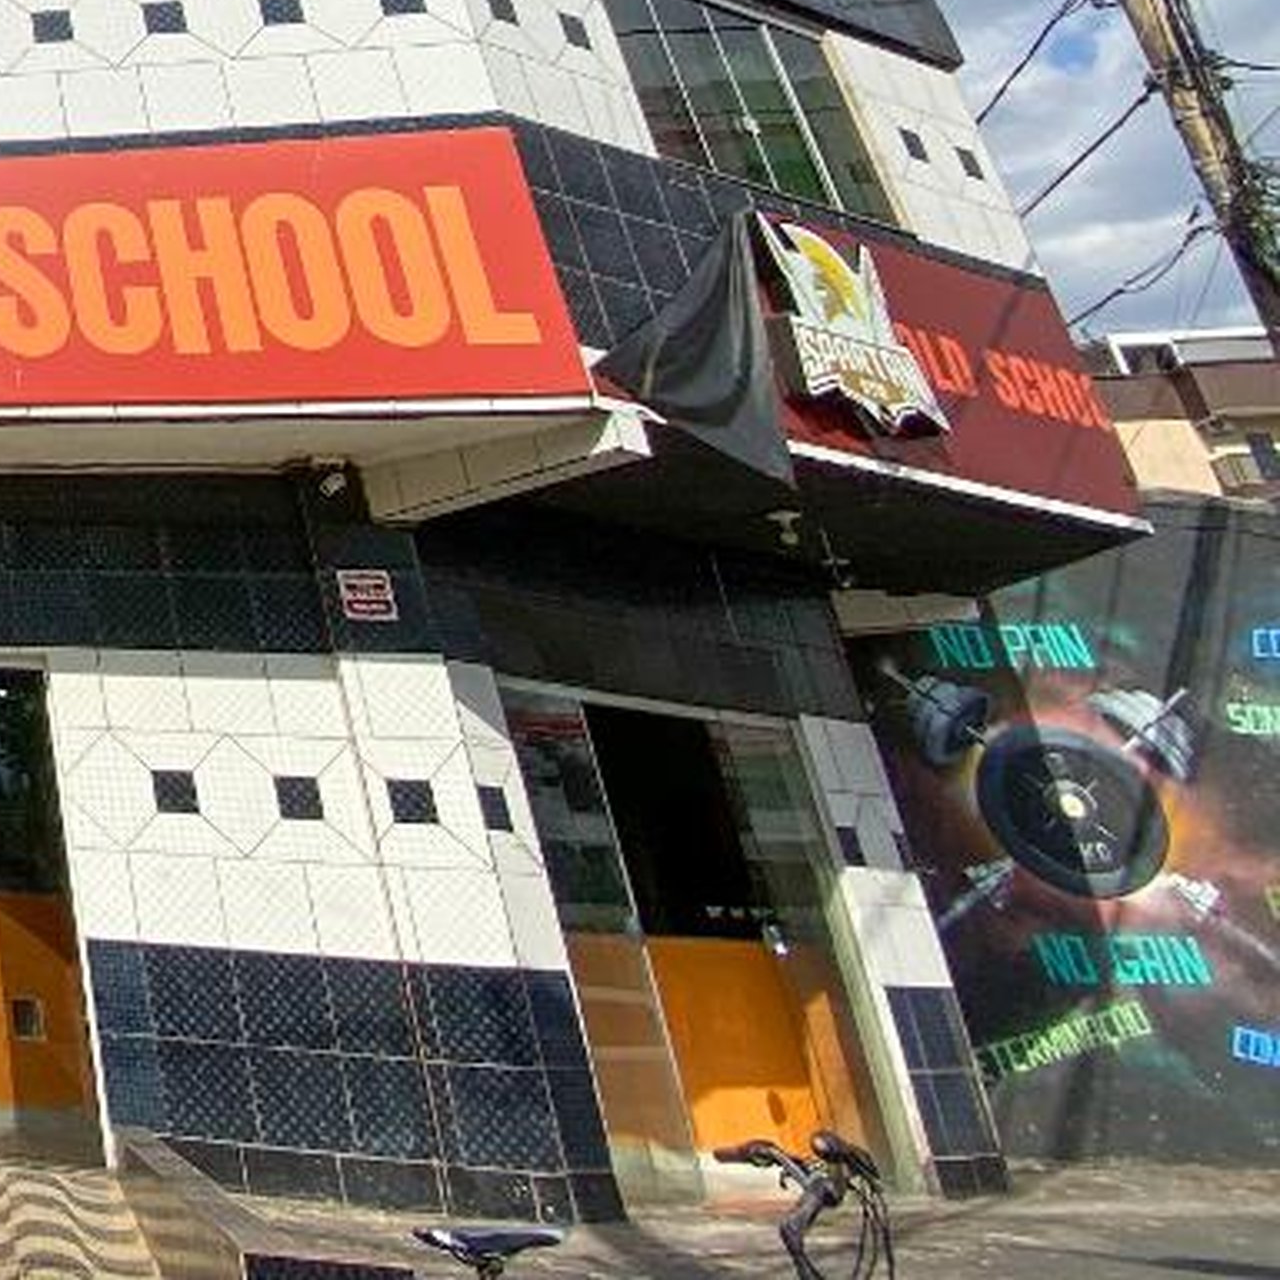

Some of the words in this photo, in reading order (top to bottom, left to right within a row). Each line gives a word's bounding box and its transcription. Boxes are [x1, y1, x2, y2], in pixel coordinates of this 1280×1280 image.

[986, 349, 1113, 433] SCHO
[929, 624, 993, 668] NO
[998, 623, 1096, 670] PAIN
[1110, 932, 1213, 985] GAIN
